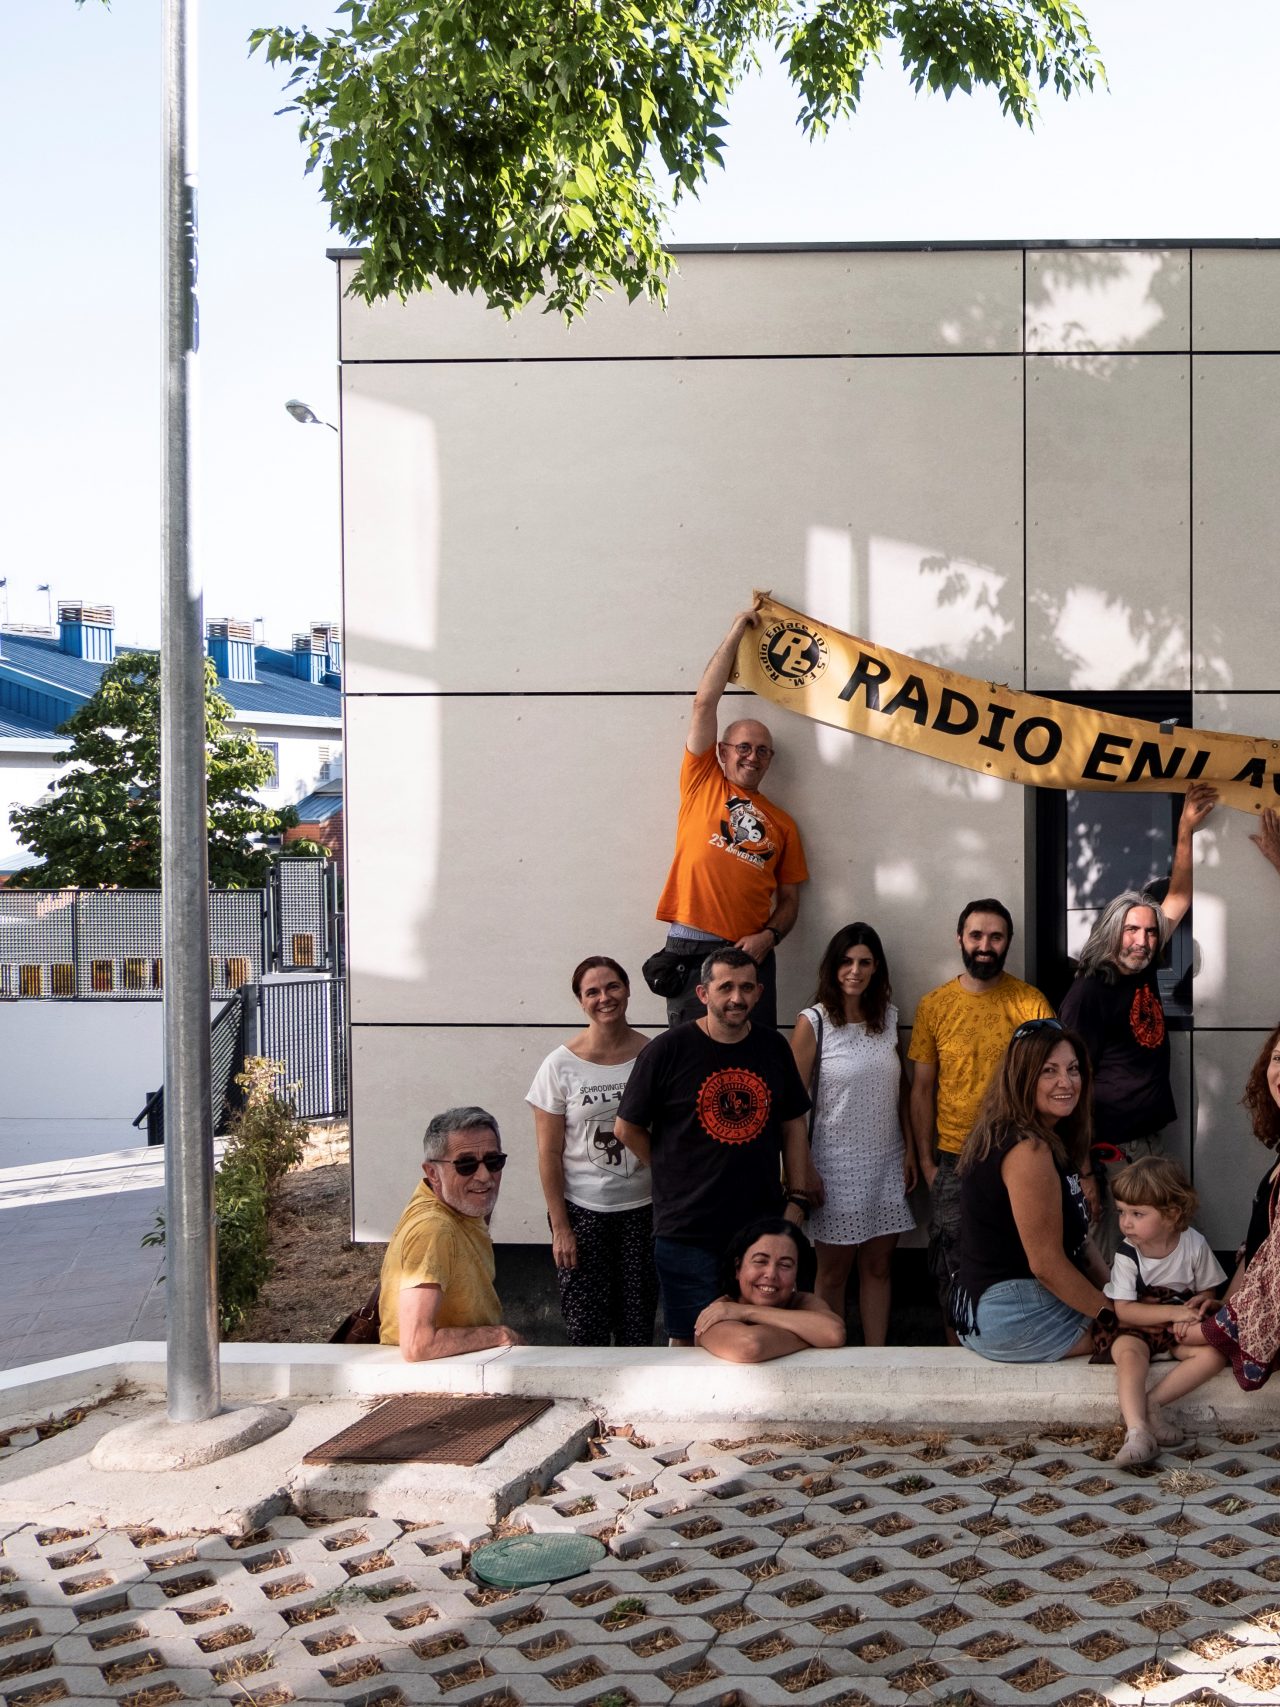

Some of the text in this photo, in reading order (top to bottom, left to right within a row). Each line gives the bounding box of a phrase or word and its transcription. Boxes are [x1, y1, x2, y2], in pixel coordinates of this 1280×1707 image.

[765, 622, 809, 640] Enlace
[760, 643, 780, 681] Radio
[770, 629, 813, 677] Re
[837, 651, 1063, 766] RADIO
[708, 832, 728, 849] 25
